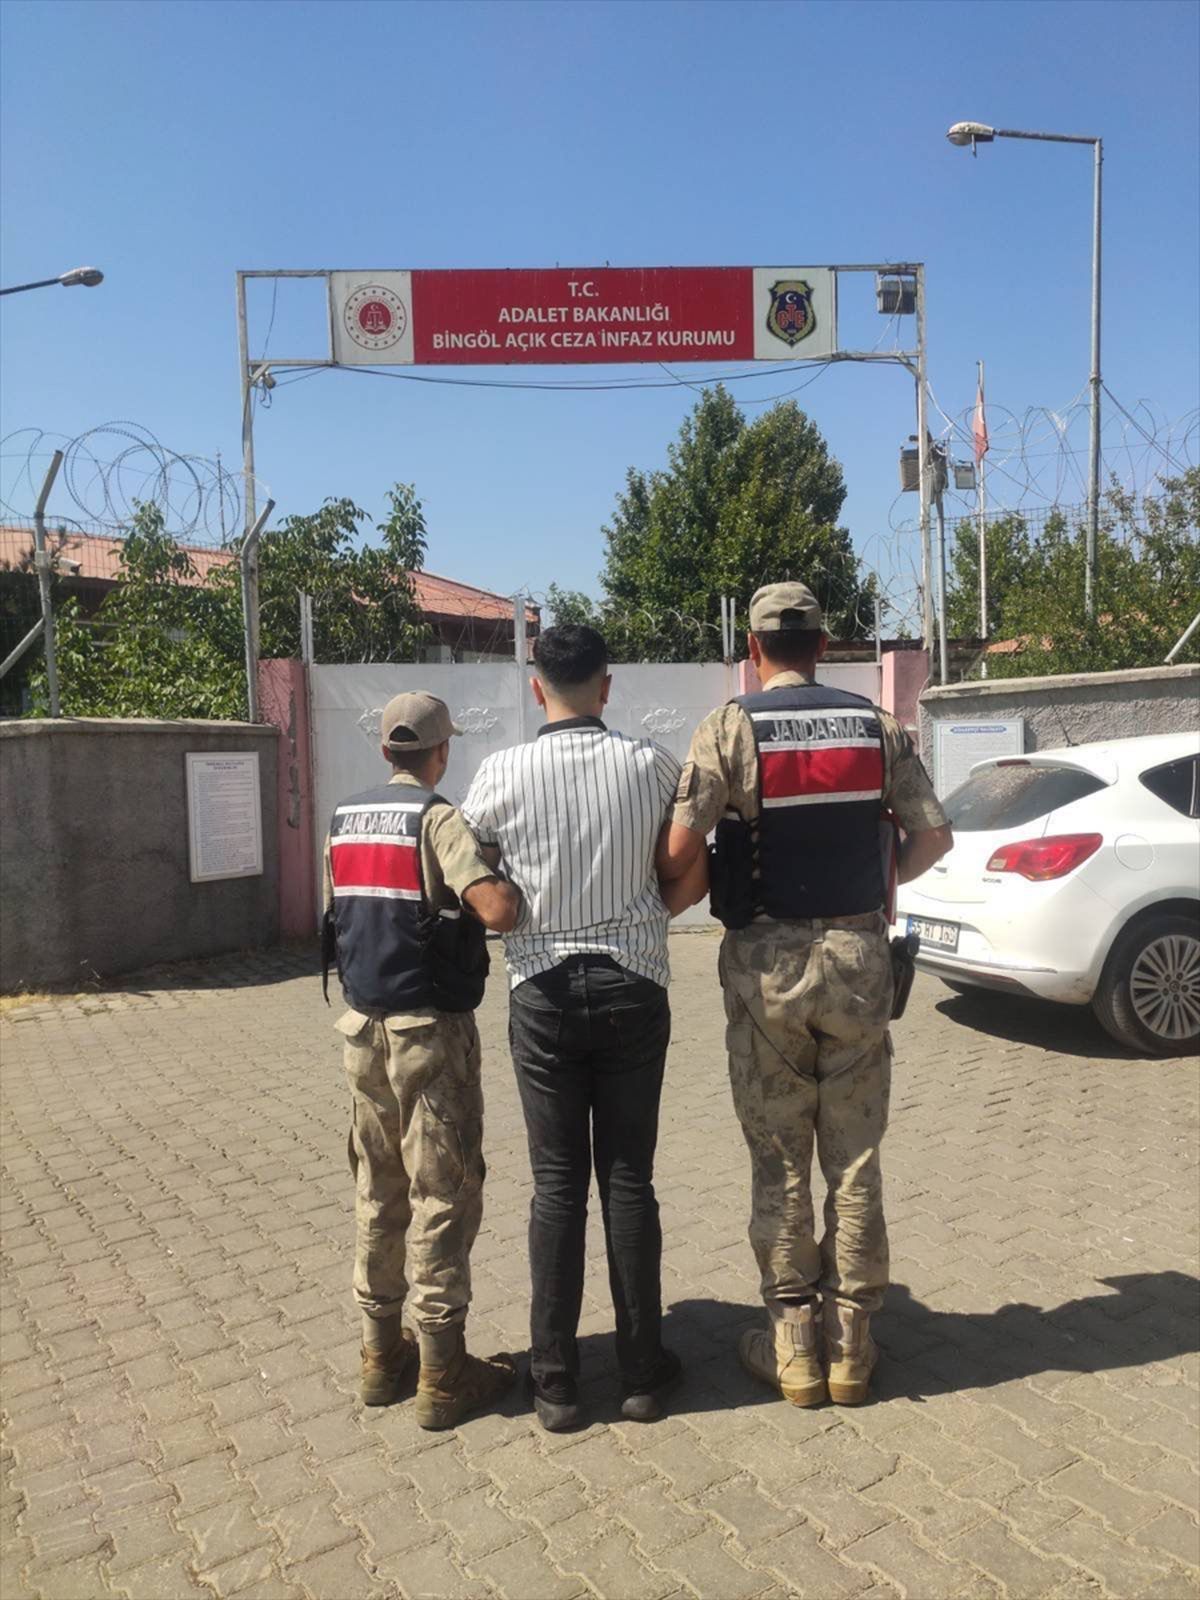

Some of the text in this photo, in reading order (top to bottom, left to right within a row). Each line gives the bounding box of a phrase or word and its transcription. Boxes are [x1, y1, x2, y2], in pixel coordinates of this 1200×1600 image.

[568, 281, 599, 297] T.C.
[498, 303, 669, 323] ADALET BAKANLIĞI
[432, 329, 735, 352] BİNGÖL AÇIK CEZA İNFAZ KURUMU
[769, 716, 868, 741] JANDARMA
[338, 811, 407, 834] JANDARMA
